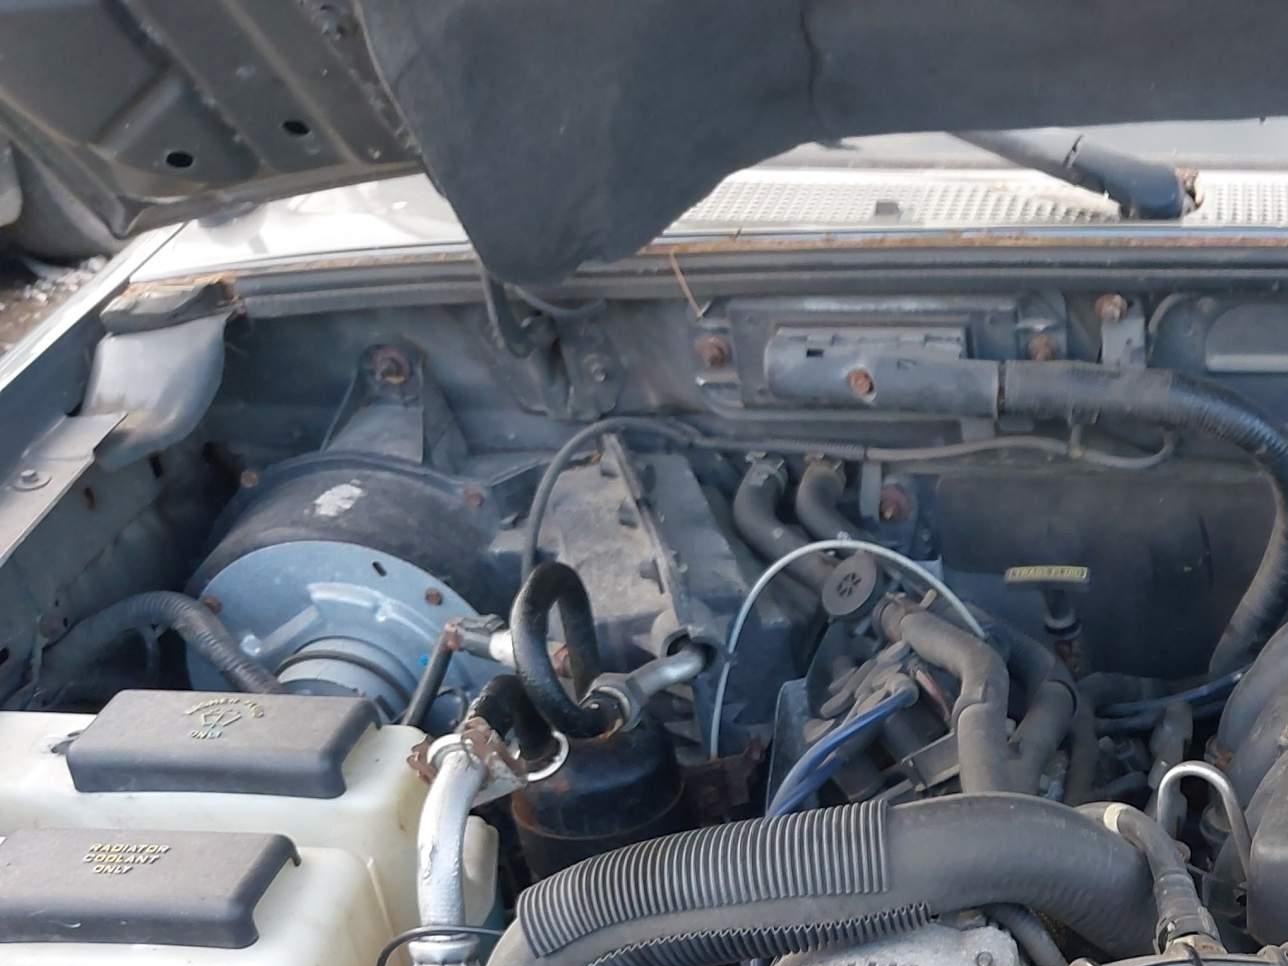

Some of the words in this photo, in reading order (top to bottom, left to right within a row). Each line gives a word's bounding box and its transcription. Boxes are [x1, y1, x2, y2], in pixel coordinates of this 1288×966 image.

[88, 844, 171, 853] RADIATOR
[82, 854, 160, 864] COOLANT
[93, 864, 134, 874] ONLY
